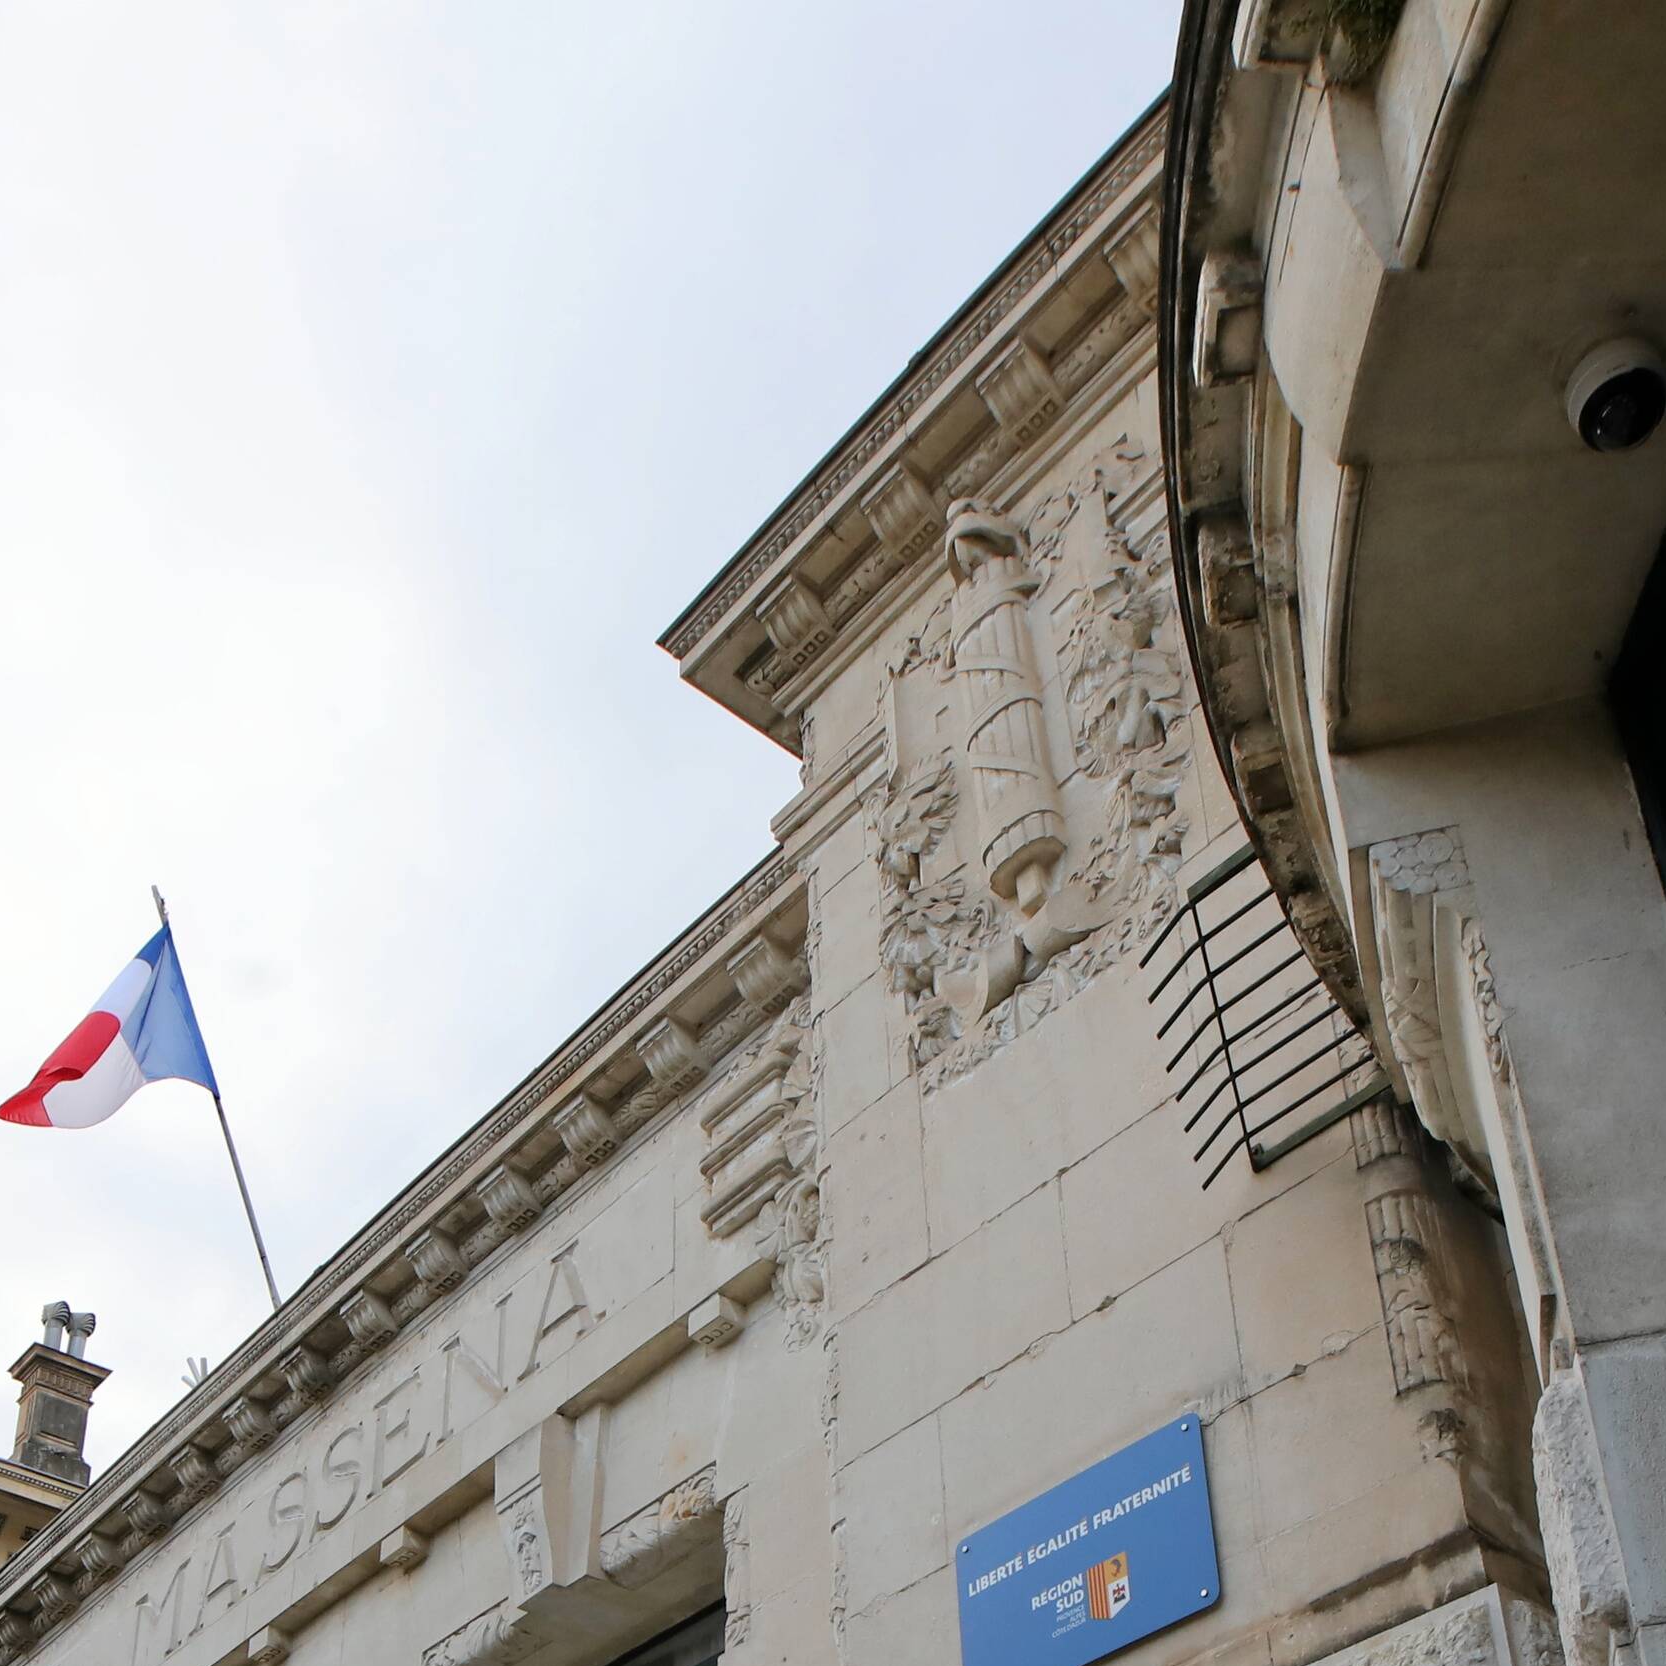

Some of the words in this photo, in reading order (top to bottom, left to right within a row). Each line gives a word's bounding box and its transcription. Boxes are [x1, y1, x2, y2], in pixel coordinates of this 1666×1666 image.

[968, 1552, 1023, 1598] LIBERTÉ
[1092, 1463, 1192, 1530] FRATERNITÉ
[1056, 1589, 1084, 1614] SUD
